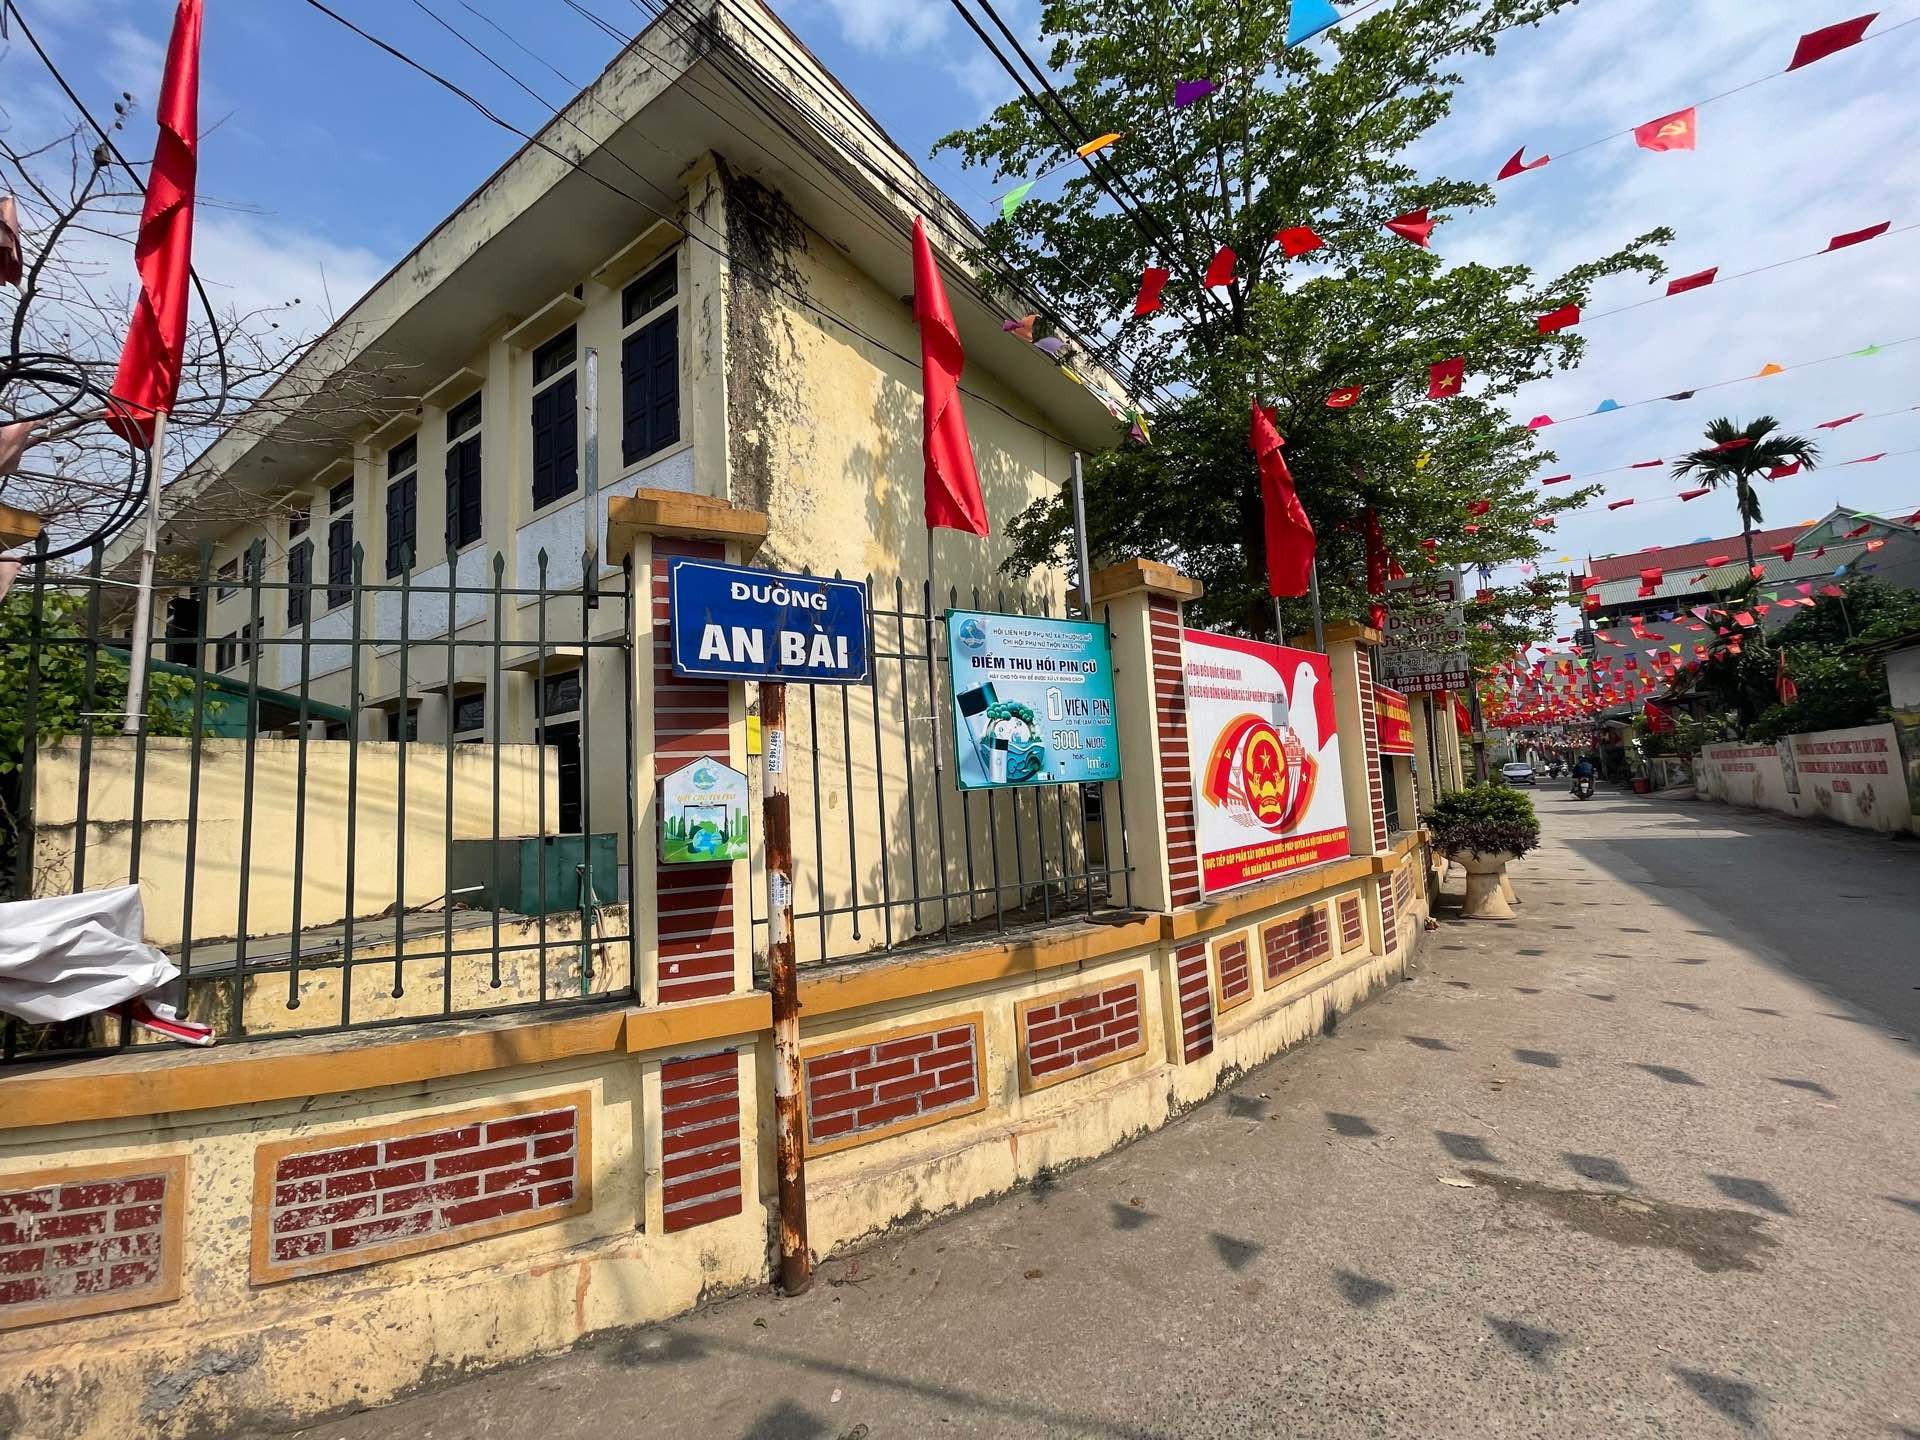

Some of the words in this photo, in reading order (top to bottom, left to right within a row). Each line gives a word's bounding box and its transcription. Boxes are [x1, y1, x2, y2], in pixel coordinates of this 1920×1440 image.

[731, 581, 827, 610] ĐƯỜNG
[699, 623, 764, 663] AN
[780, 625, 848, 669] BÀI
[972, 652, 1005, 669] ĐIỂM
[1009, 658, 1032, 670] THU
[1036, 656, 1055, 671] HỒI
[1059, 660, 1078, 672] PIN
[1424, 674, 1442, 682] 812
[1446, 672, 1464, 680] 198
[1425, 683, 1443, 691] 863
[1050, 692, 1060, 715] 1
[1065, 697, 1088, 716] VIÊN
[1093, 699, 1109, 716] PIN
[1052, 730, 1083, 750] 500L
